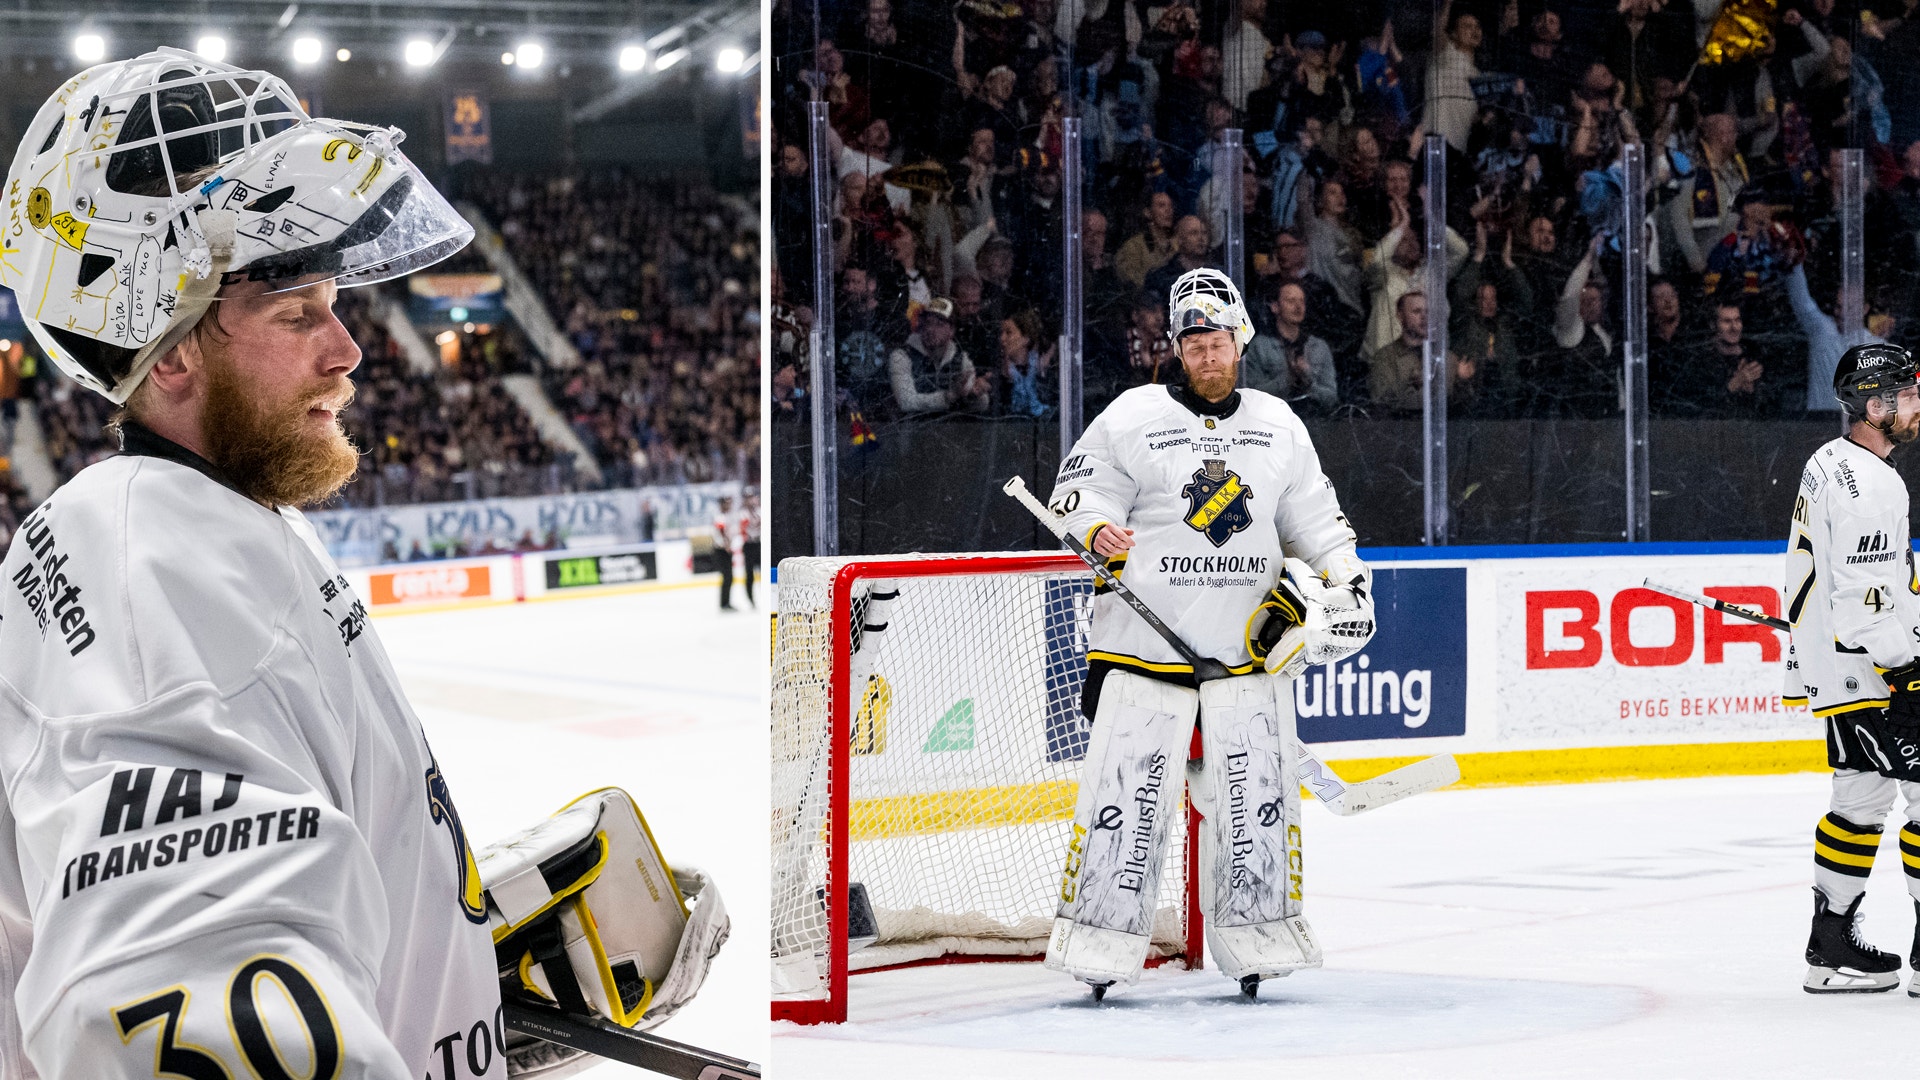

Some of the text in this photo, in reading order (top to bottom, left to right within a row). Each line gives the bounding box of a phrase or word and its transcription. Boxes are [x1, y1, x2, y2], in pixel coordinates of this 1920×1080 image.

[264, 151, 287, 189] ELNAZ
[136, 288, 144, 317] LOVE
[110, 301, 126, 338] Heja
[1856, 356, 1884, 371] ÅBRO
[1145, 428, 1273, 439] HOCKEYGEAR TEAMGEAR
[1056, 468, 1094, 485] RANSPORTER
[1856, 530, 1888, 553] HÅJ
[1159, 556, 1268, 574] STOCKHOLMS
[1846, 552, 1897, 565] TRANSPORTE
[1080, 550, 1129, 595] CCM
[1169, 577, 1258, 588] Måleri & Byggkonsulter
[1129, 597, 1148, 613] XF
[1722, 601, 1770, 621] CCM
[1620, 699, 1670, 718] BYGG
[62, 806, 321, 900] TRANSPORTER
[1061, 822, 1087, 904] CCM
[1287, 823, 1304, 902] CCM
[110, 952, 346, 1080] 30
[553, 1029, 572, 1039] GRIP
